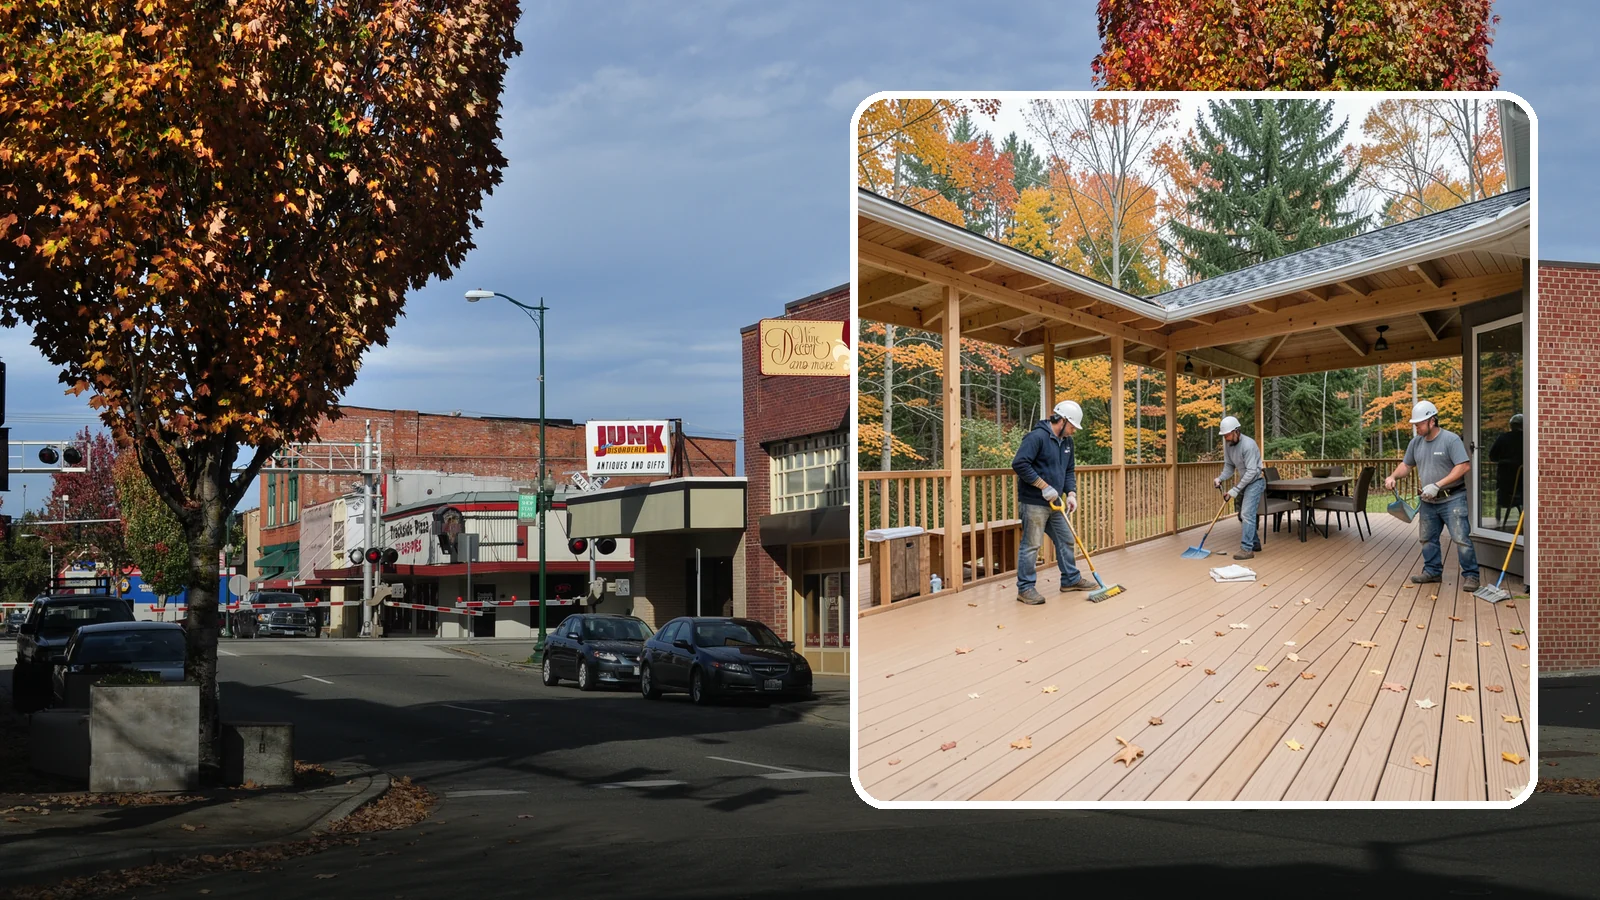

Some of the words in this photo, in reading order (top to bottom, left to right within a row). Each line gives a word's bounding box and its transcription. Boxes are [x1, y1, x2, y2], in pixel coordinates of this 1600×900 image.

[595, 425, 665, 457] JUNK
[607, 446, 646, 454] DISORDERLY
[597, 461, 628, 470] ANTIQUES
[631, 461, 644, 470] AND
[646, 460, 665, 470] GIFTS
[390, 521, 413, 540] Trackside
[414, 519, 429, 535] Pizza
